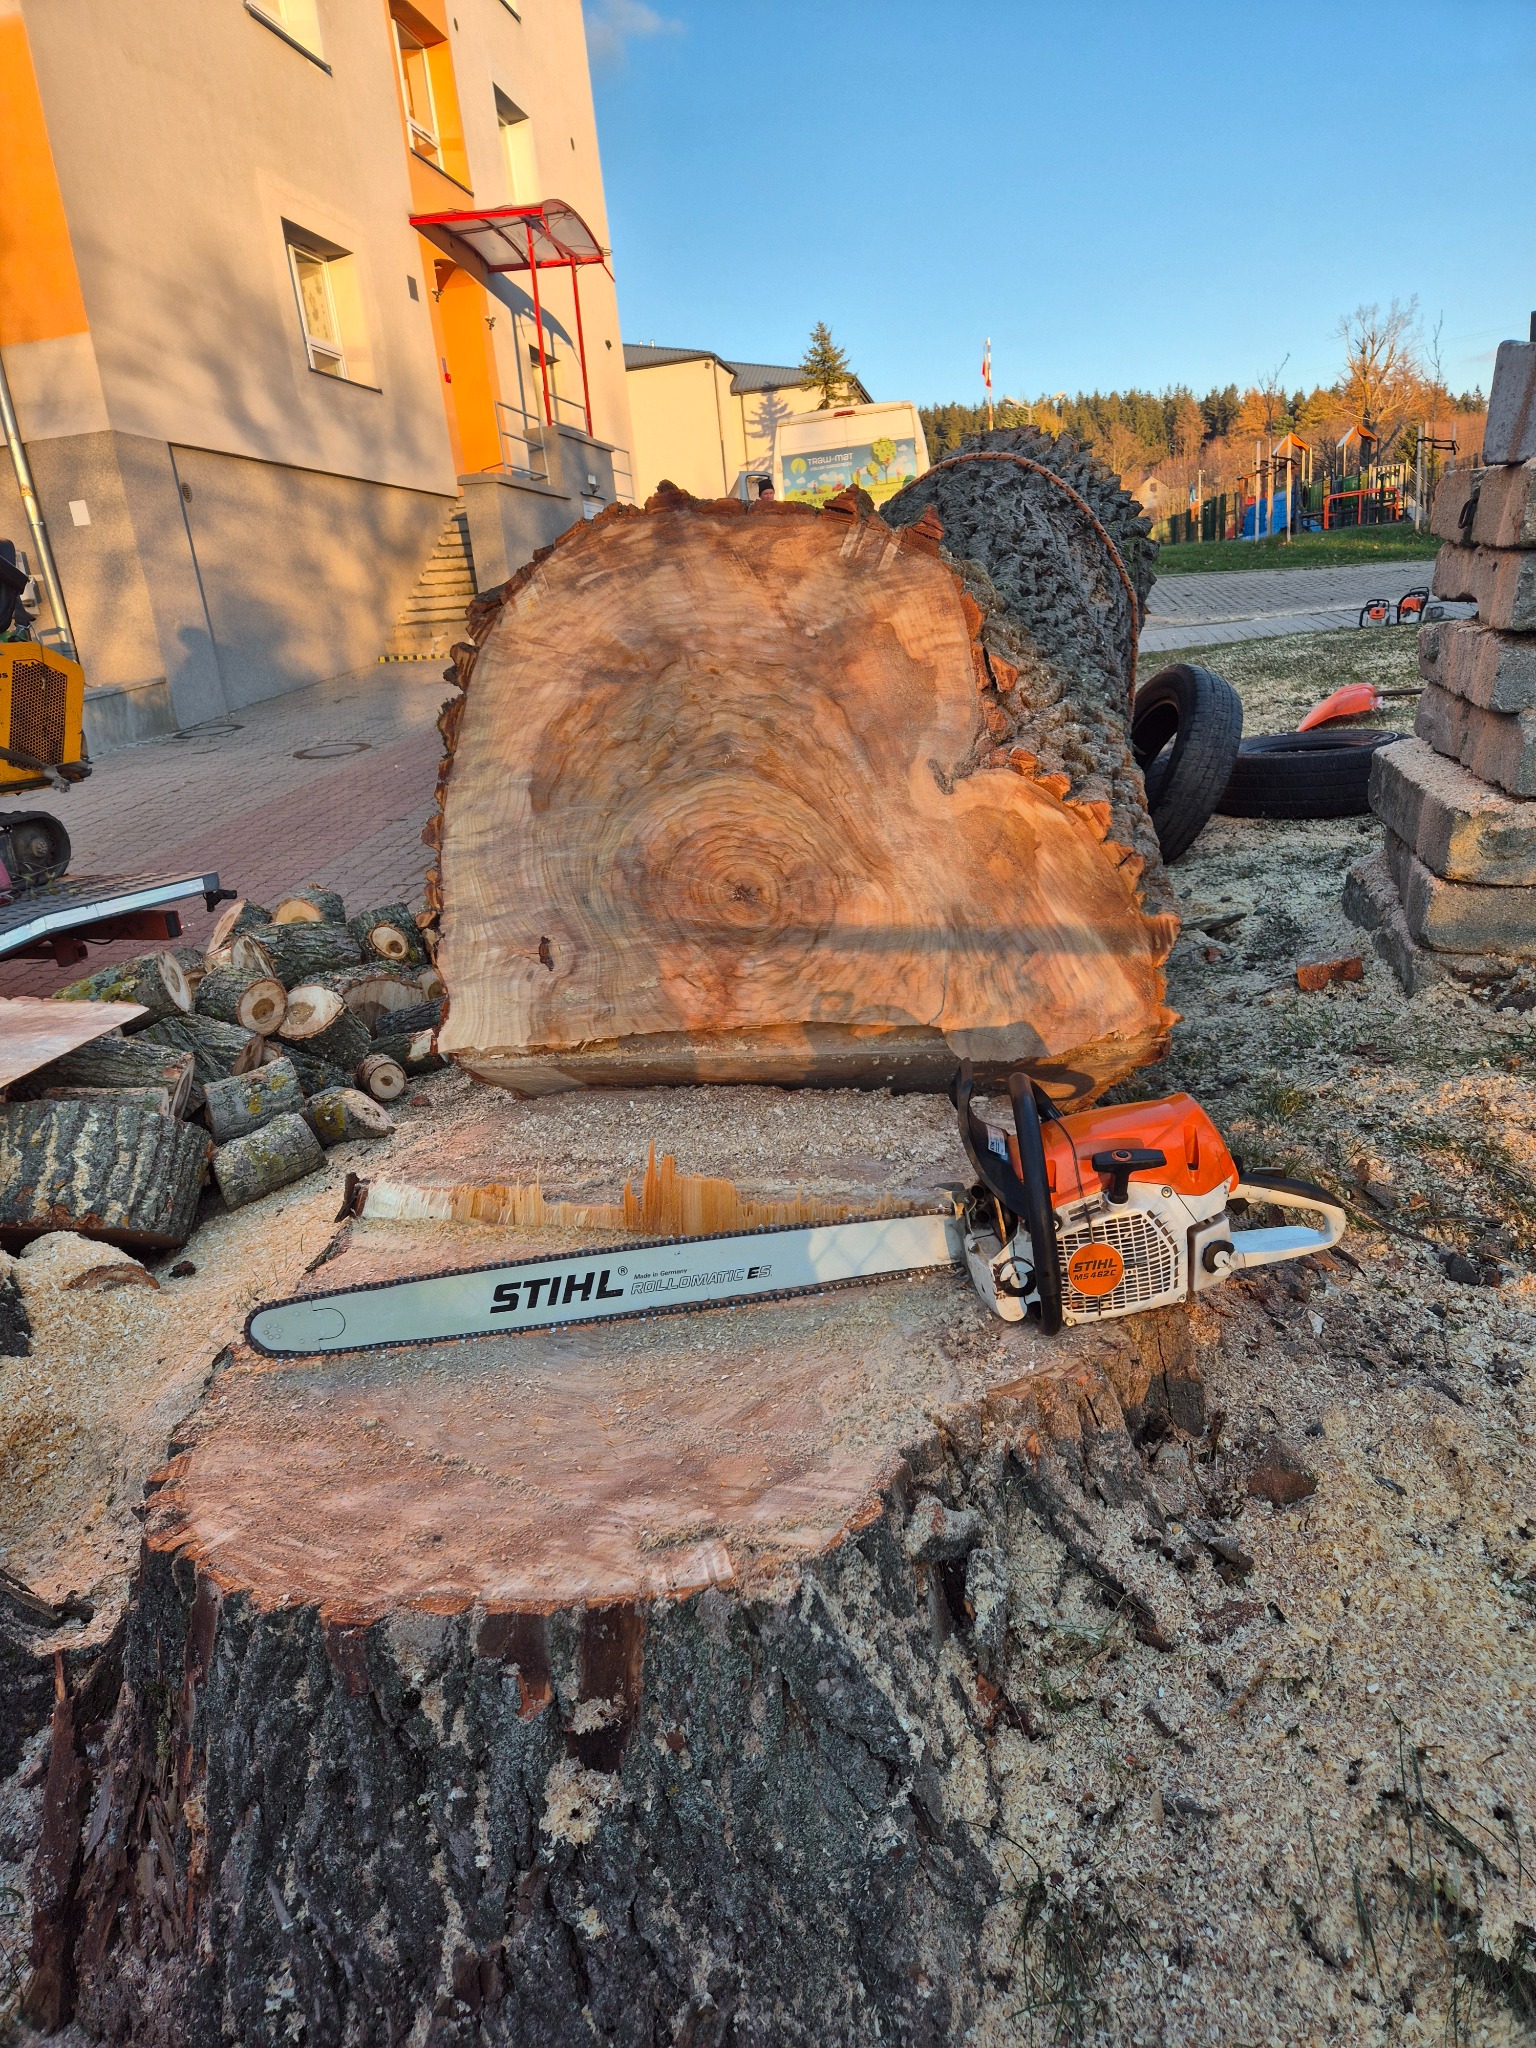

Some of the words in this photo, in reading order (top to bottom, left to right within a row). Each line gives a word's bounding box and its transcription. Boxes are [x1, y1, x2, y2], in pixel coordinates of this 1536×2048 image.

[1073, 1258, 1117, 1272] STIHL
[660, 1269, 688, 1277] Germany
[631, 1268, 745, 1295] ROLLOMATIC
